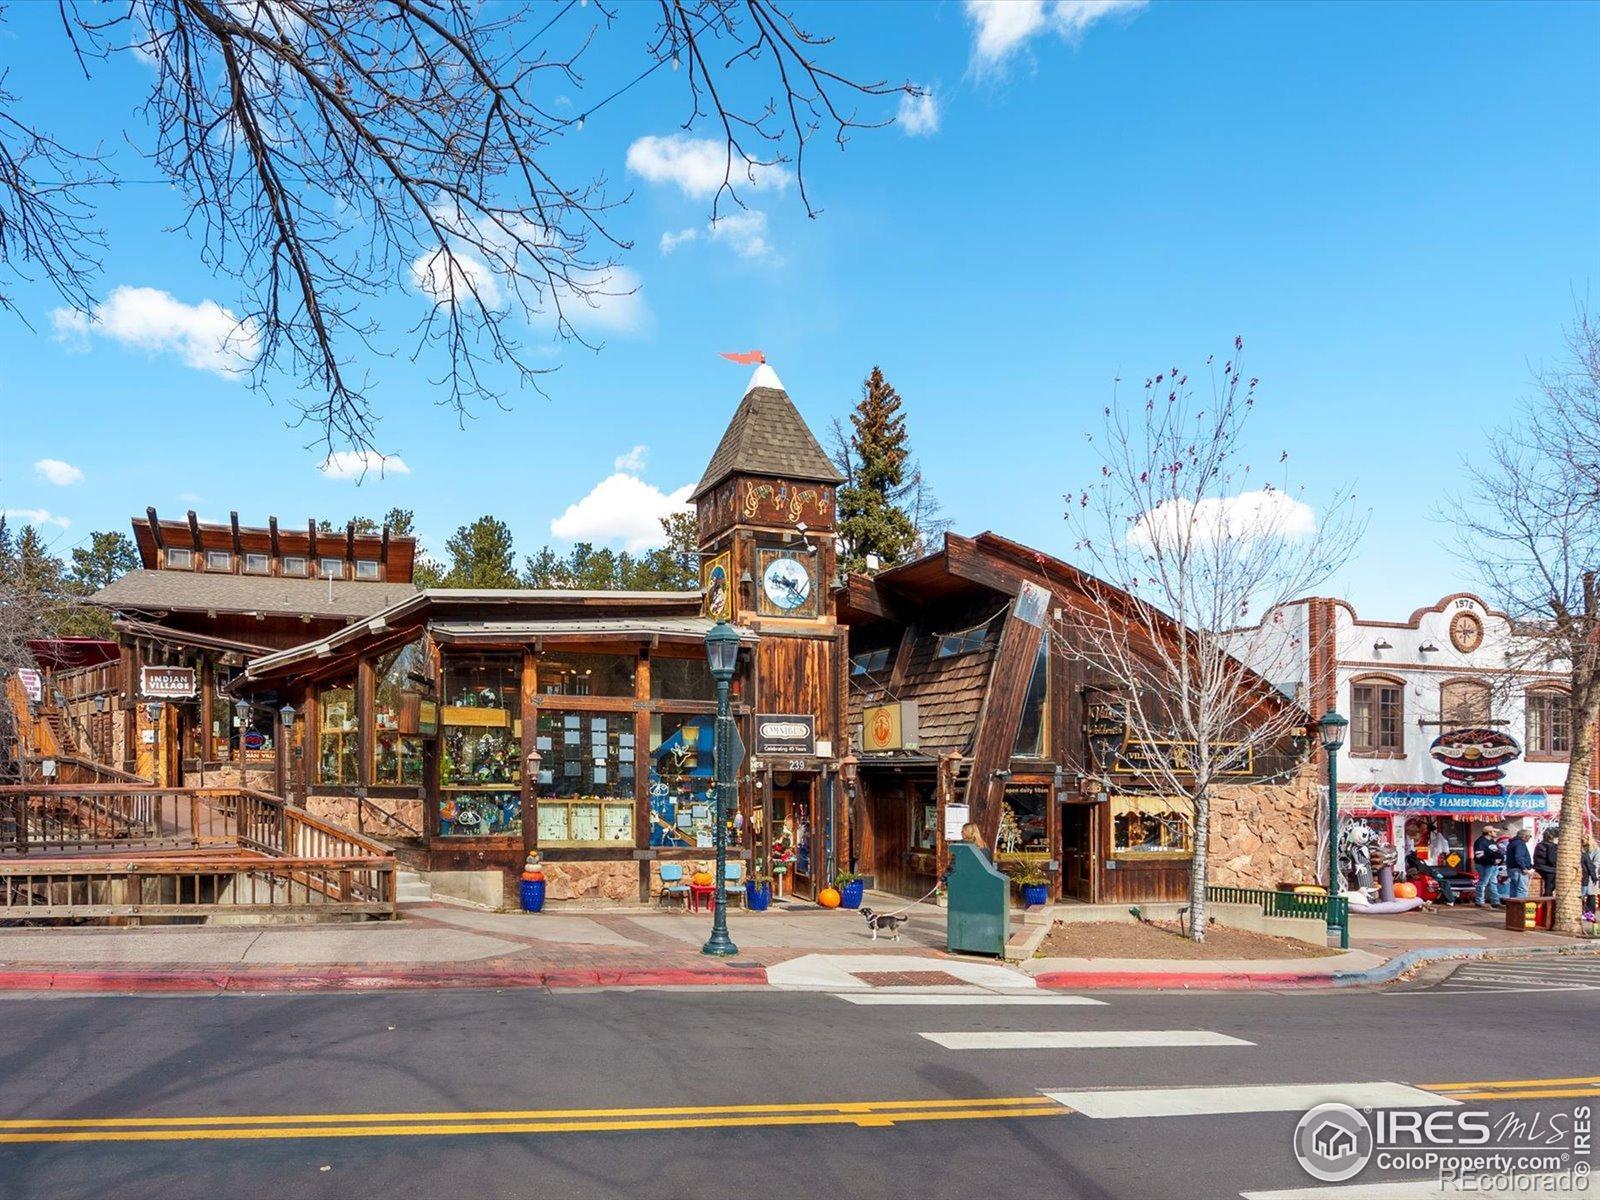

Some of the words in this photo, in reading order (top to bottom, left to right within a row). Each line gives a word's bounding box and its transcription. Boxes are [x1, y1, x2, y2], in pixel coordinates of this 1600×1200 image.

[150, 675, 188, 683] INDIAN
[149, 682, 190, 690] VILLAGE
[765, 725, 805, 737] OMNIBUS
[789, 760, 805, 770] 239
[1439, 797, 1505, 810] HAMBURGERS
